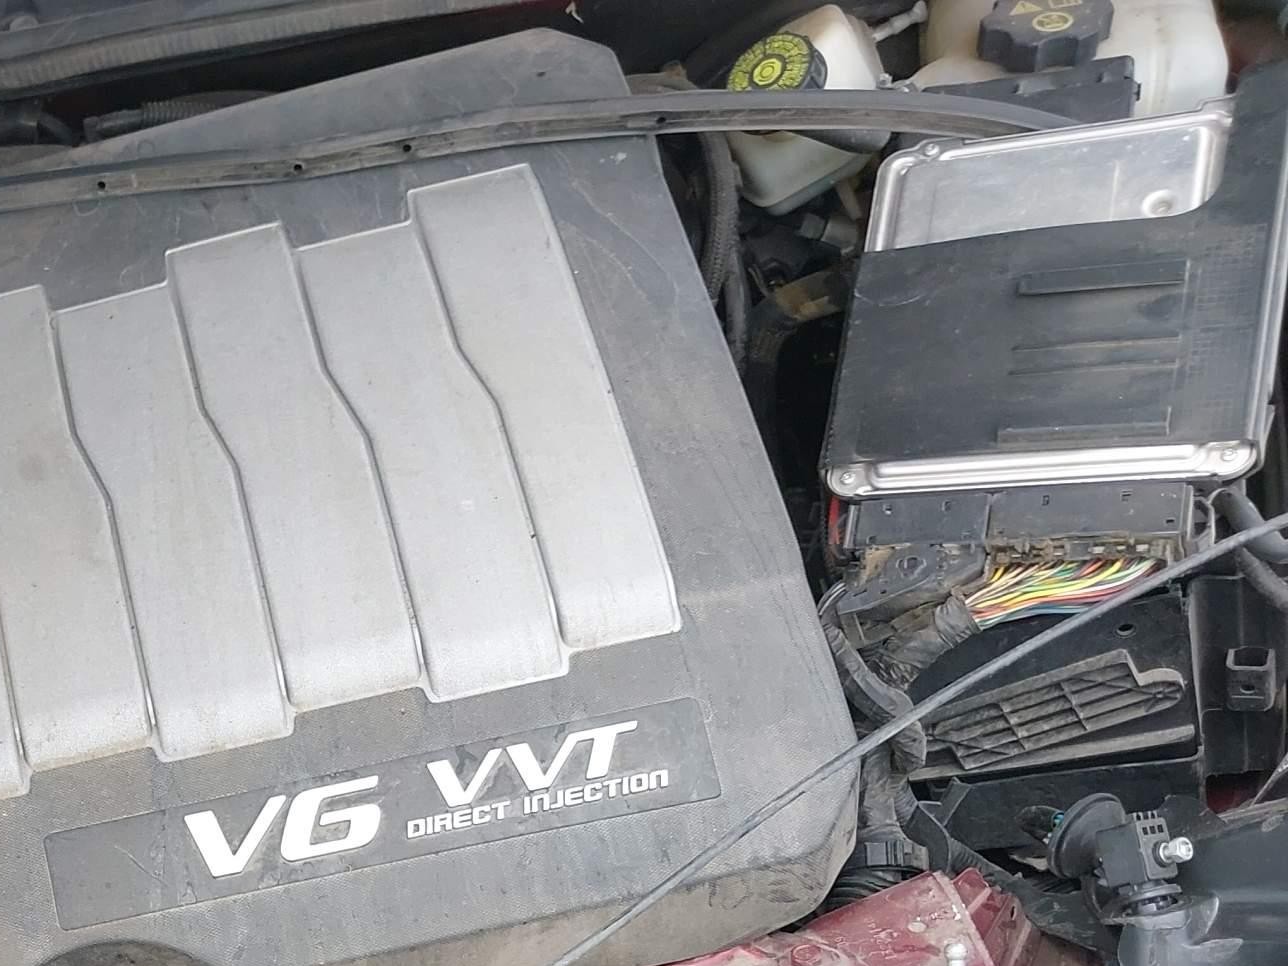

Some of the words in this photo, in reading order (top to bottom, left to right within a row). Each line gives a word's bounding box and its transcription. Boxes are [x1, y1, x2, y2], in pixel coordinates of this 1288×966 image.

[184, 775, 381, 878] V6
[426, 720, 638, 808] VVT
[407, 800, 510, 839] DIRECT
[523, 769, 669, 815] INJECTION
